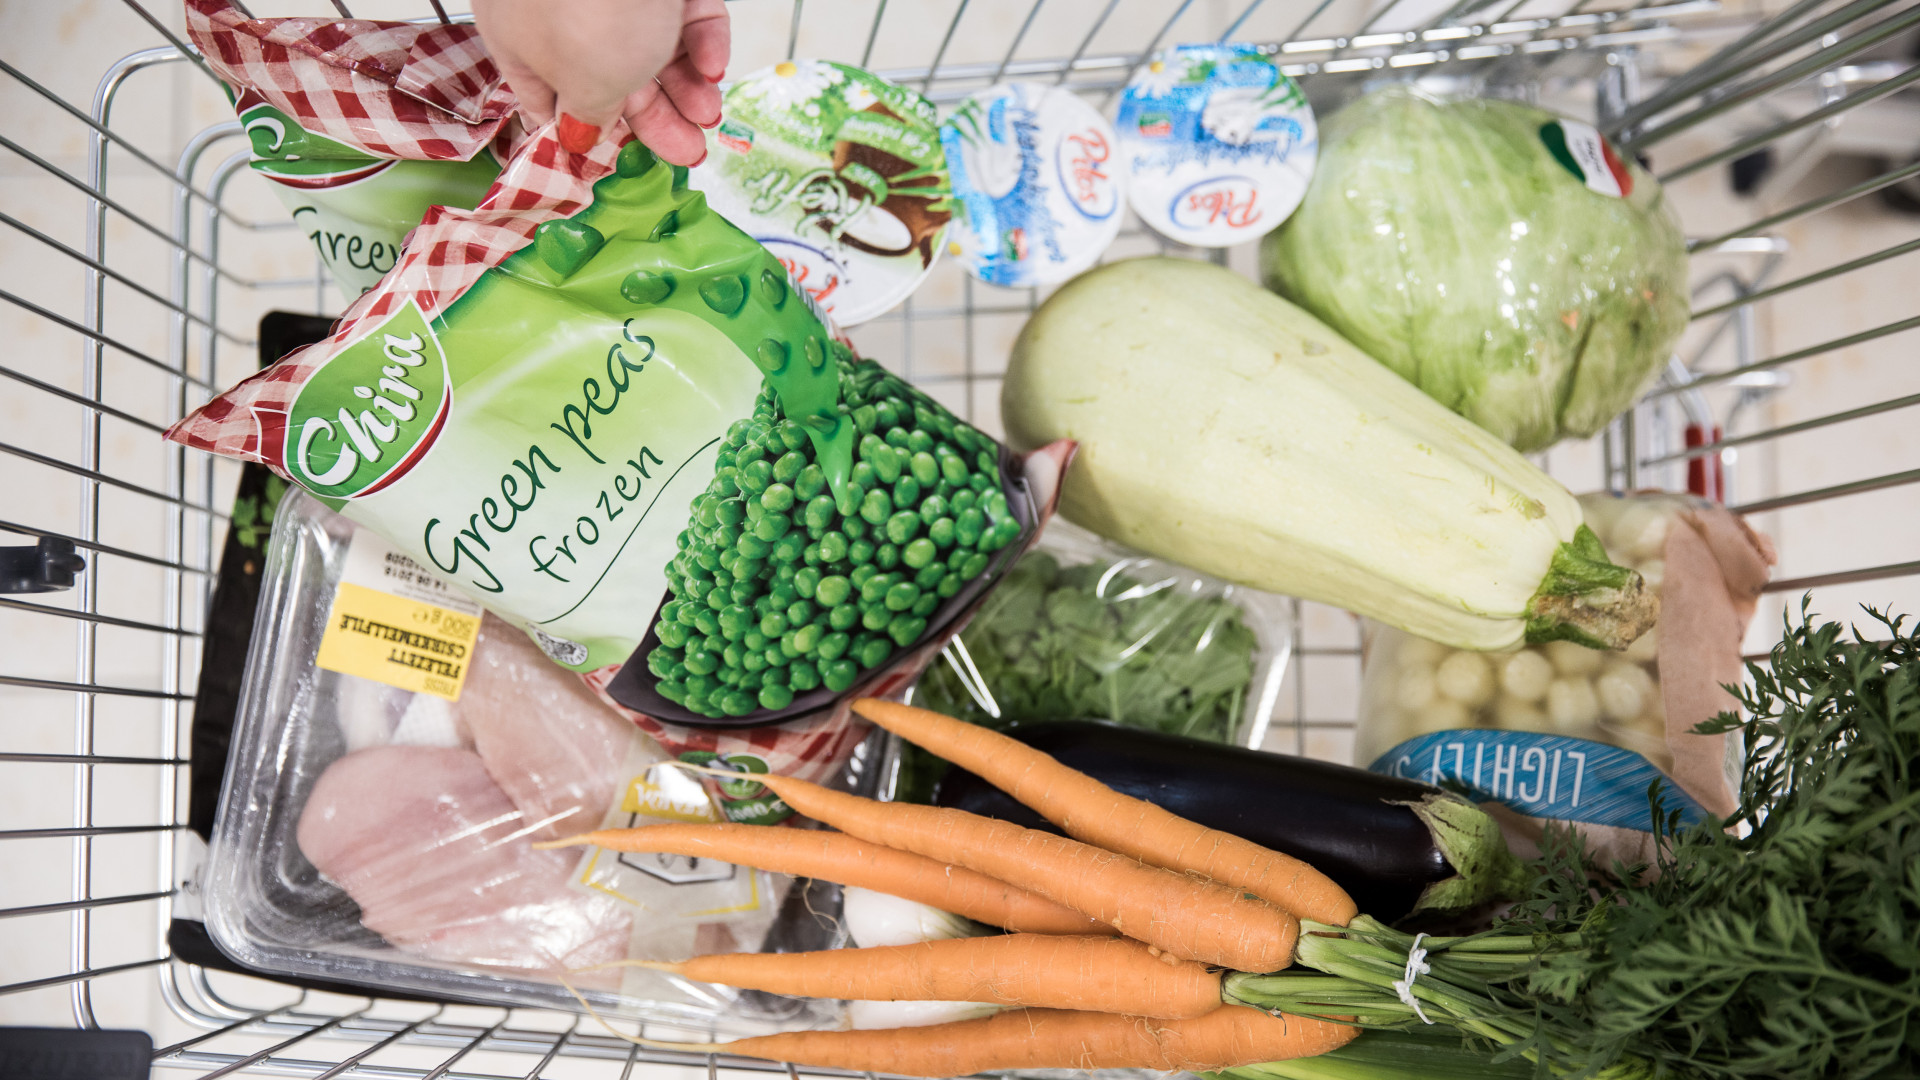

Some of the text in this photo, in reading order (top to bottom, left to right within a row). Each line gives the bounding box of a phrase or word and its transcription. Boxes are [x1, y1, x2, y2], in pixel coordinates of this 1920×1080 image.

[1067, 126, 1111, 206] Pilos
[1188, 187, 1264, 229] Pilos
[297, 330, 427, 487] Chira
[424, 444, 562, 593] Green
[550, 317, 656, 465] peas
[528, 445, 664, 583] frozen
[1430, 742, 1587, 808] LIGHTLY
